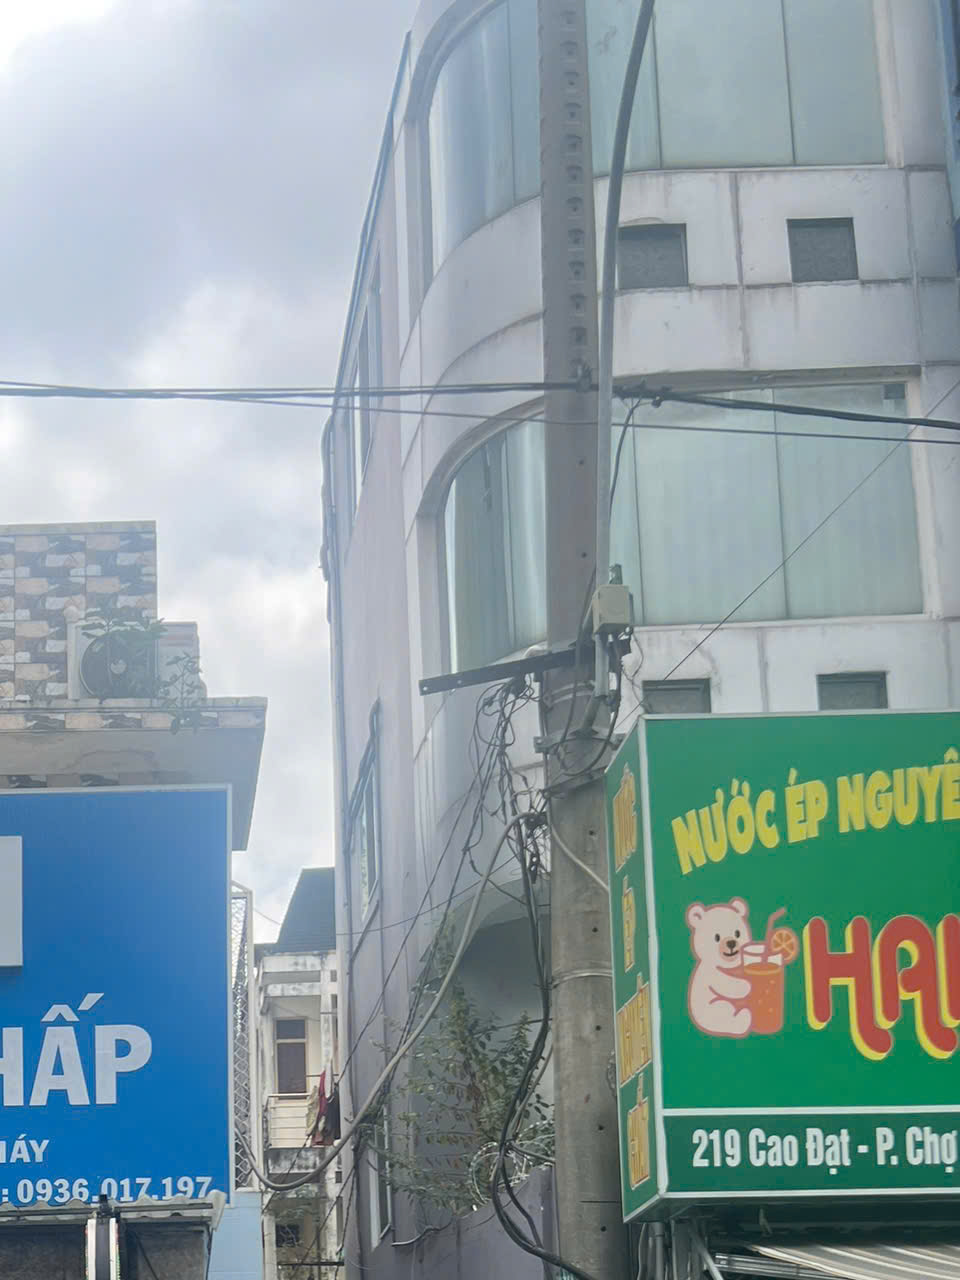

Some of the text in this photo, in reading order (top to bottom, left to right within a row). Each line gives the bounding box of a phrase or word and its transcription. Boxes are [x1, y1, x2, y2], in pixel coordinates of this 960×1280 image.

[672, 778, 780, 875] NƯỚC
[785, 768, 828, 843] ÉP
[692, 1126, 959, 1175] 219 Cao Đạt P. Chợ
